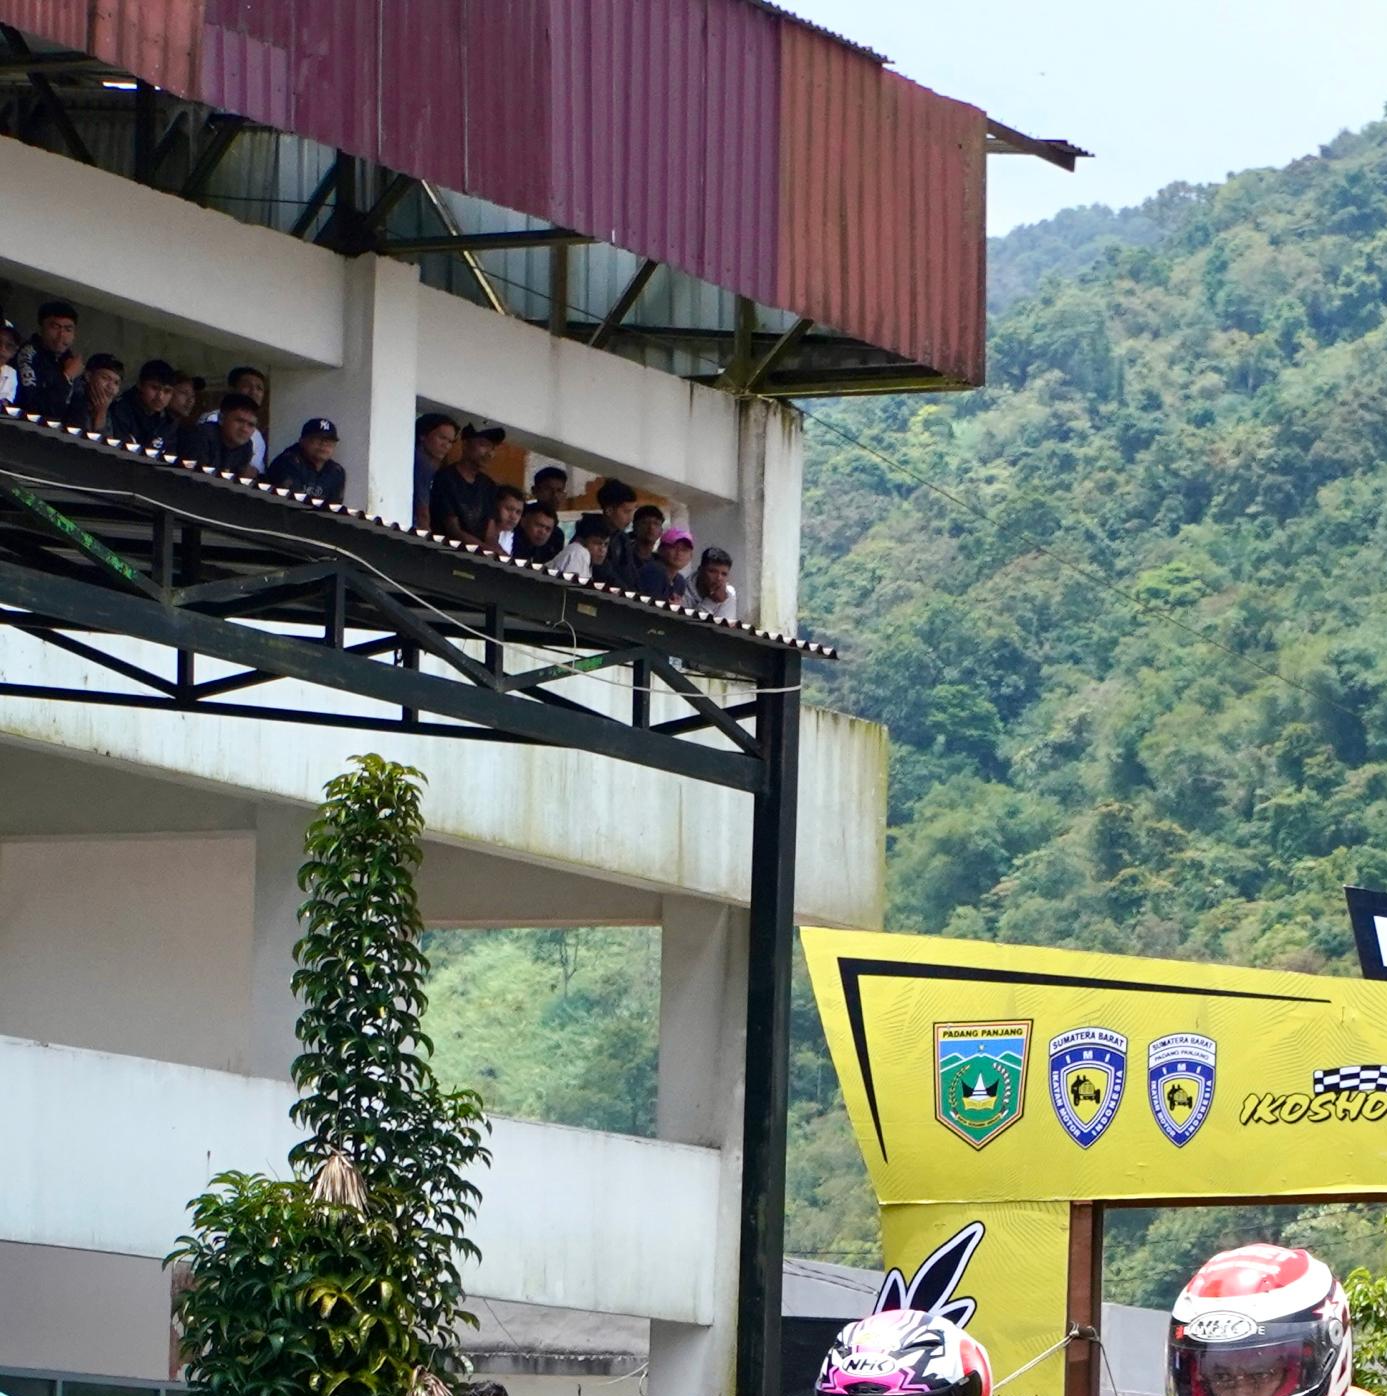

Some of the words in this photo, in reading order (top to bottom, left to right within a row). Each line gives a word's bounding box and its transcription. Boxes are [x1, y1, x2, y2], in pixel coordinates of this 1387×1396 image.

[942, 1029, 979, 1039] PADANG
[981, 1028, 1024, 1038] PANJANG
[1052, 1031, 1096, 1050] SUMATERA
[1099, 1032, 1124, 1048] BARAT
[1152, 1036, 1189, 1051] SUMATERA
[1091, 1070, 1123, 1136] INDONESIA
[846, 1357, 888, 1373] NHK
